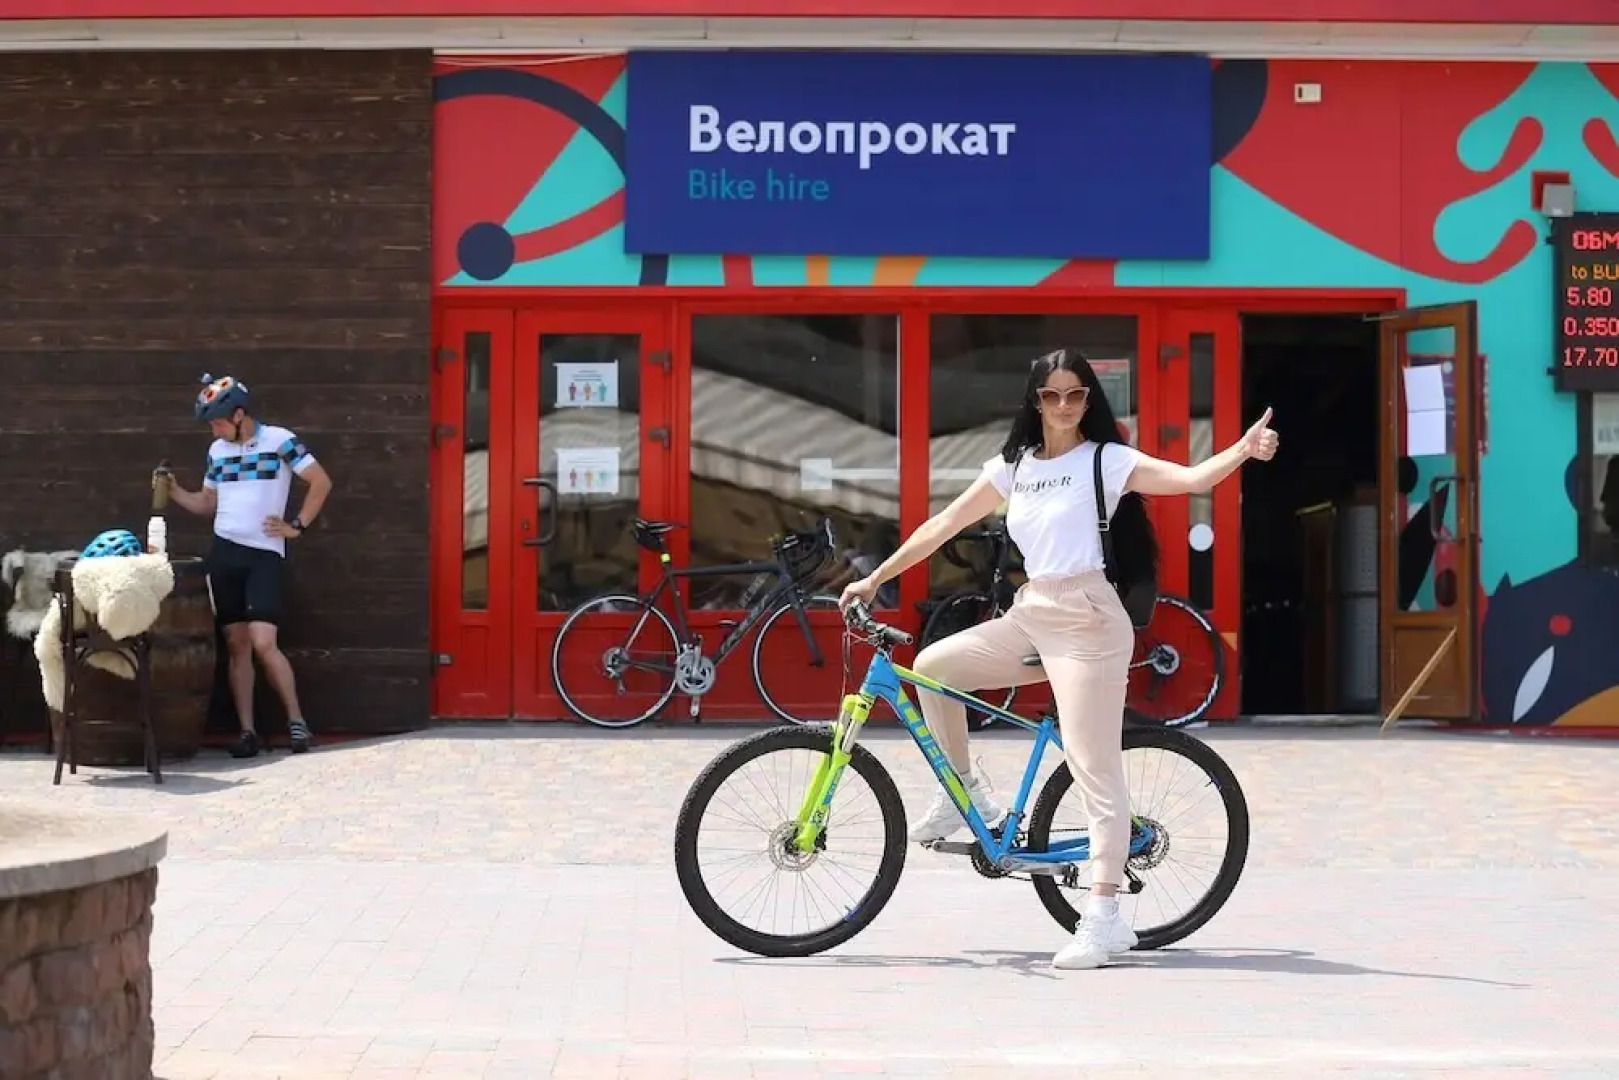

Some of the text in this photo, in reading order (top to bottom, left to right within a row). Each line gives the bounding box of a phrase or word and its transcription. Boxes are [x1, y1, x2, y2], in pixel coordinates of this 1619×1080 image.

[690, 105, 1016, 169] Велопрокат
[688, 168, 830, 200] Bike hire
[1571, 264, 1587, 279] to
[1567, 286, 1612, 306] 5.80
[1564, 317, 1619, 336] 0.350
[1563, 347, 1618, 367] 17.70
